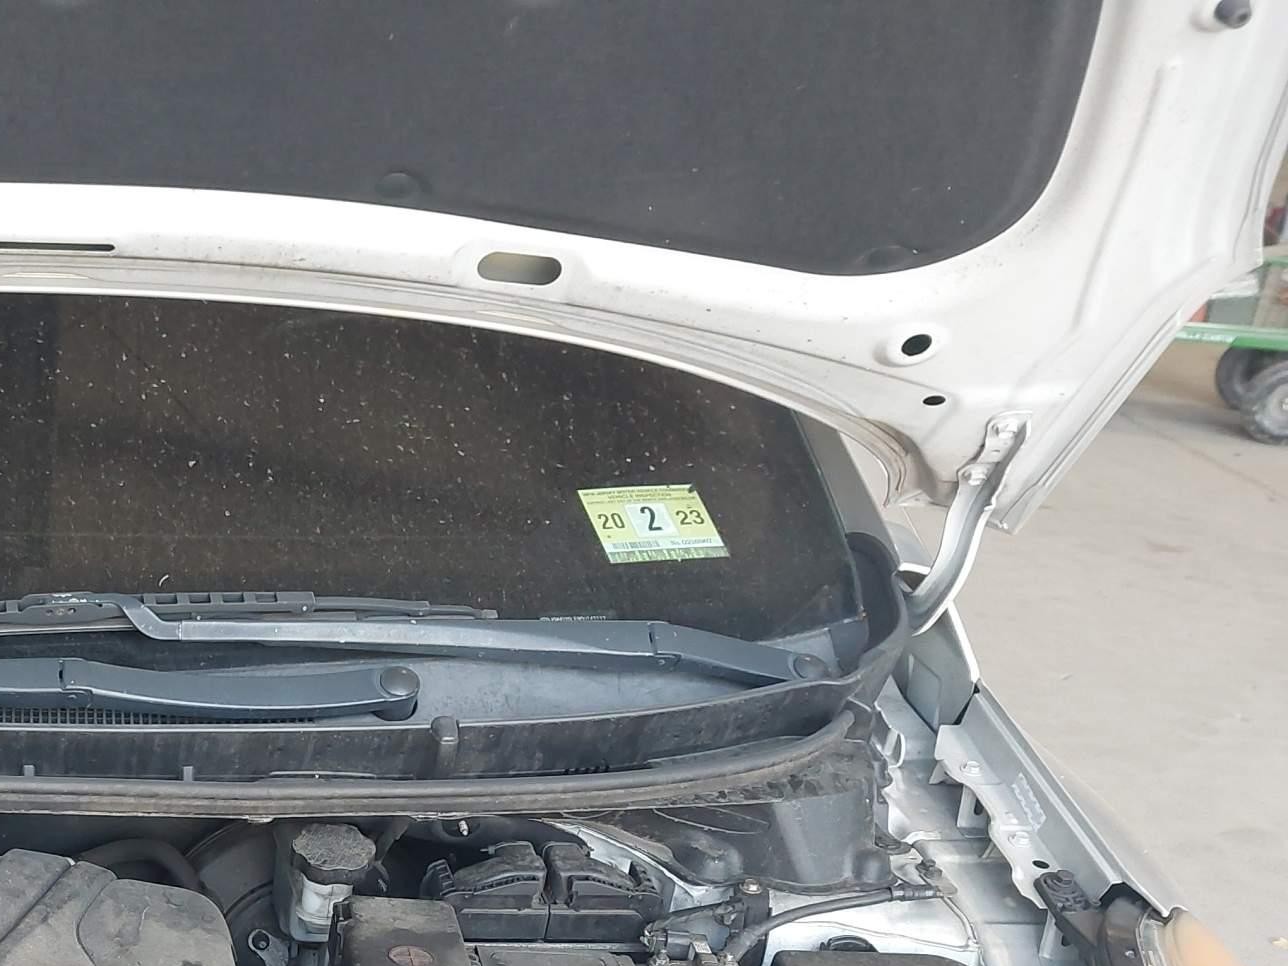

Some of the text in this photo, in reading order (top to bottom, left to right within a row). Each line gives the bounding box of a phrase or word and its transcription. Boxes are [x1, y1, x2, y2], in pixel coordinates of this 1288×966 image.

[598, 506, 705, 532] 20 2 23
